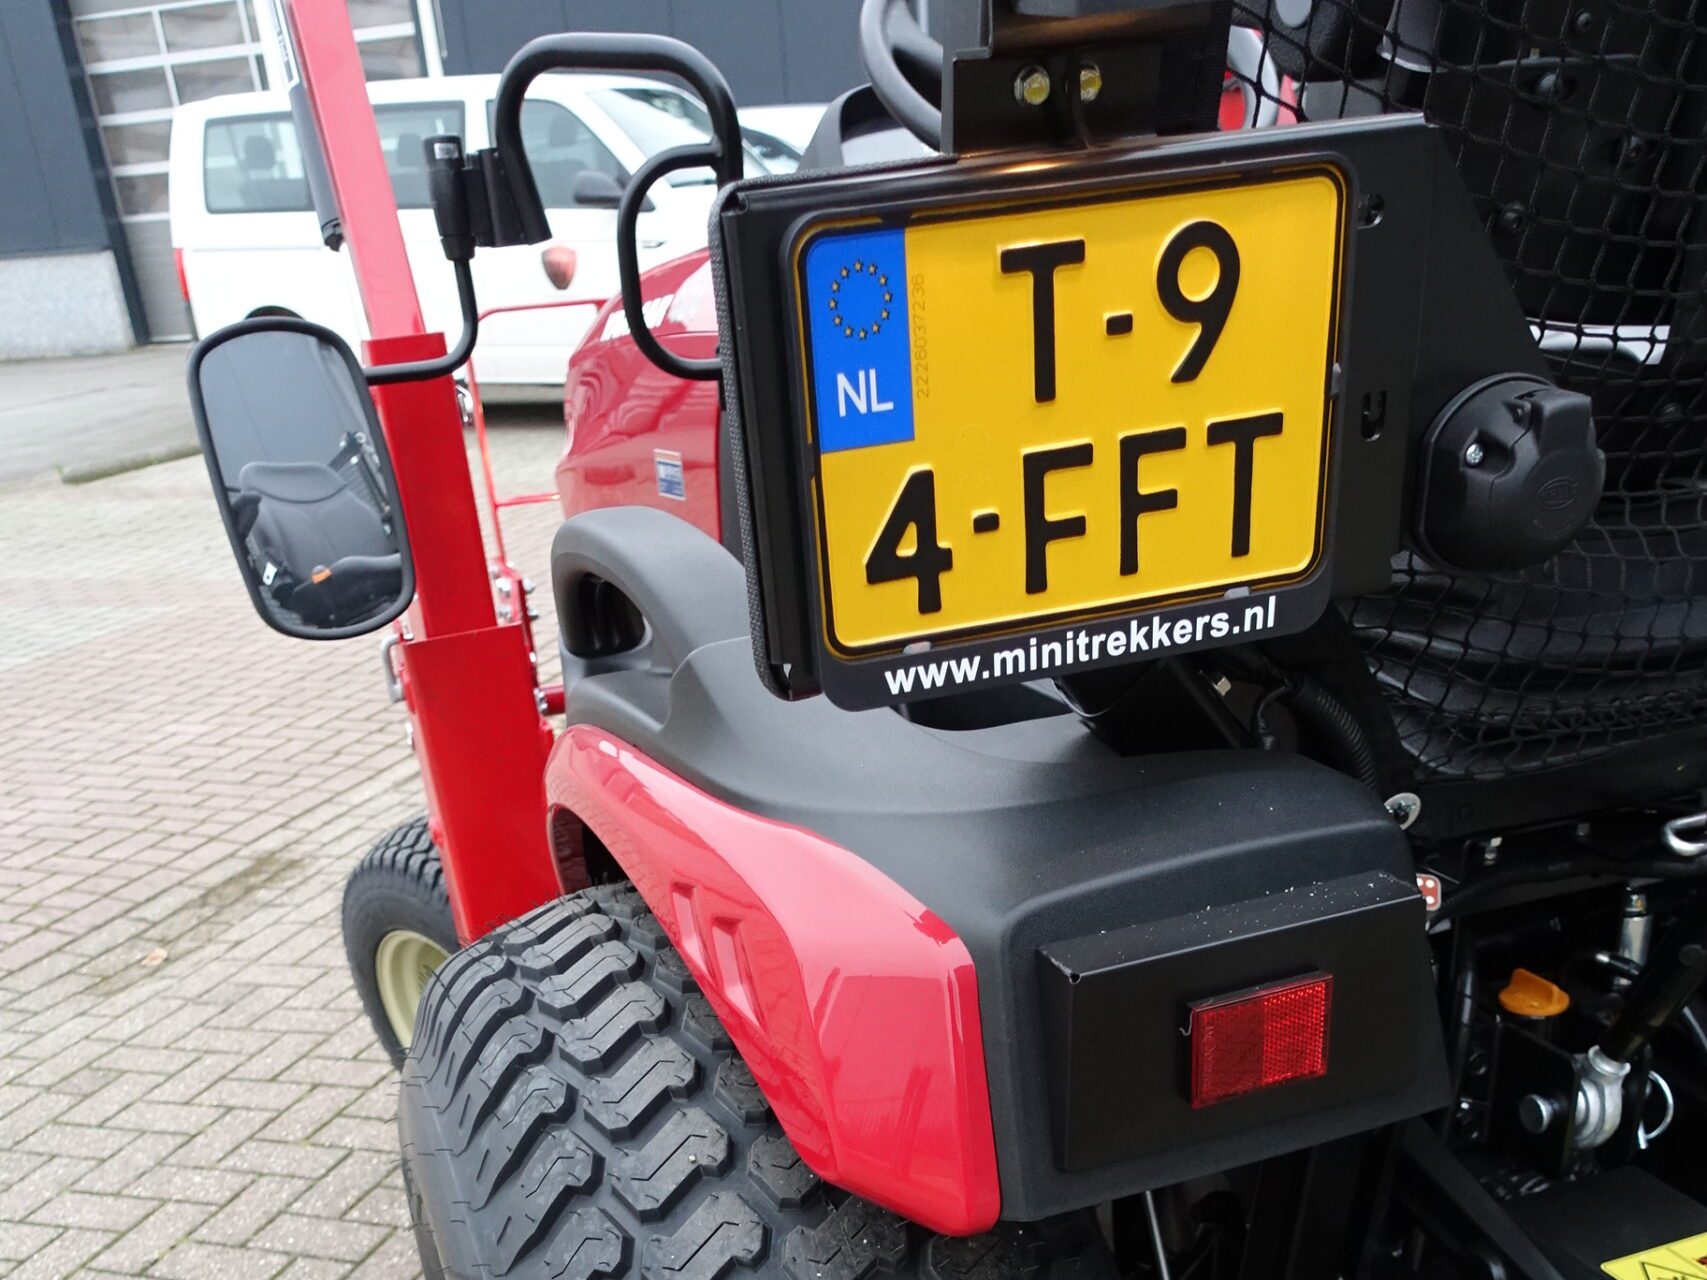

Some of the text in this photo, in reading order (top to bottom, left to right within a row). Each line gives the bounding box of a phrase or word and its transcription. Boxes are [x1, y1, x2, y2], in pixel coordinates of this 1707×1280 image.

[1000, 220, 1241, 403] T-9
[837, 369, 893, 417] NL
[865, 412, 1284, 614] 4-FFT
[884, 595, 1277, 696] www.minitrekkers.nl
